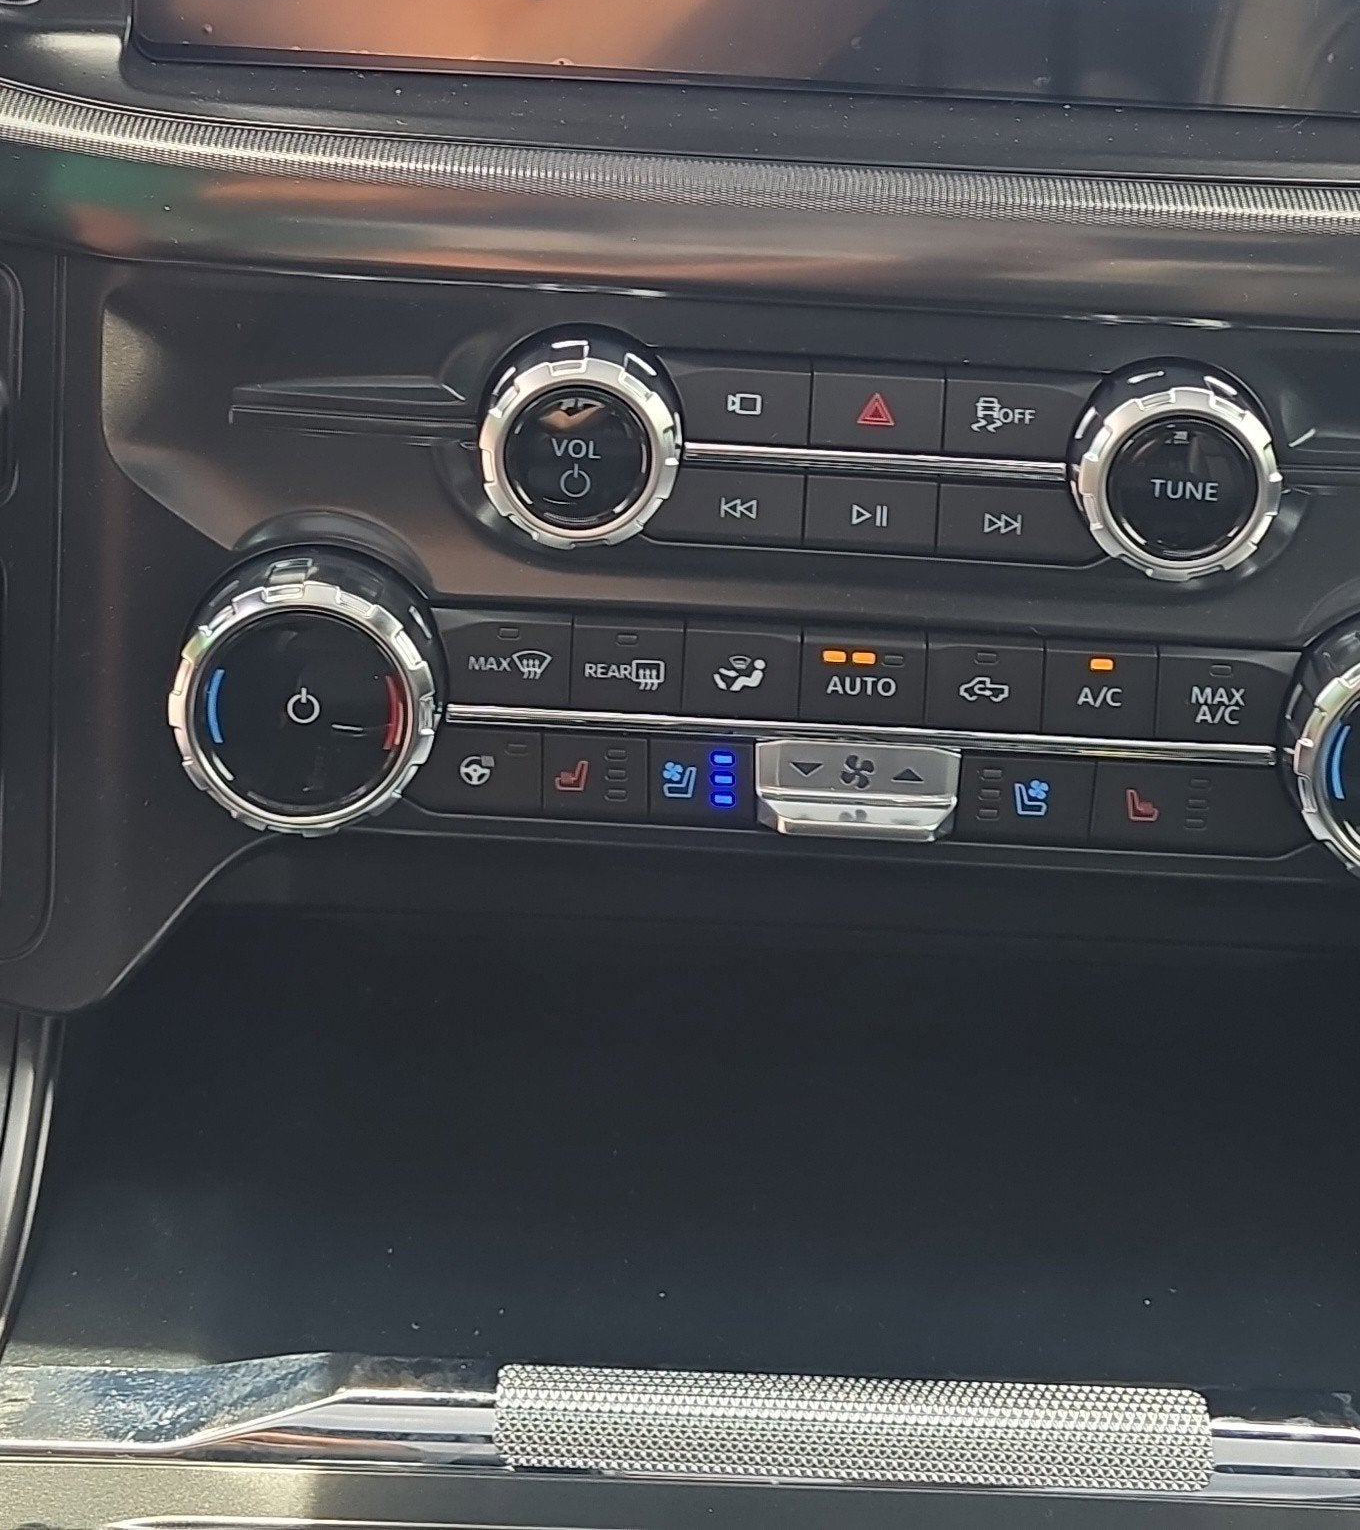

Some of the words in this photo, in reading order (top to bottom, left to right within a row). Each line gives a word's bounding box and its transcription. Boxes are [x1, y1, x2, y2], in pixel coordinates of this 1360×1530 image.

[999, 407, 1036, 425] OFF
[551, 437, 601, 460] VOL
[1150, 478, 1220, 502] TUNE
[468, 654, 512, 672] MAX
[584, 663, 631, 680] REAR
[826, 676, 897, 698] AUTO
[1077, 685, 1122, 708] A/C
[1190, 686, 1245, 706] MAX
[1195, 704, 1240, 726] A/C
